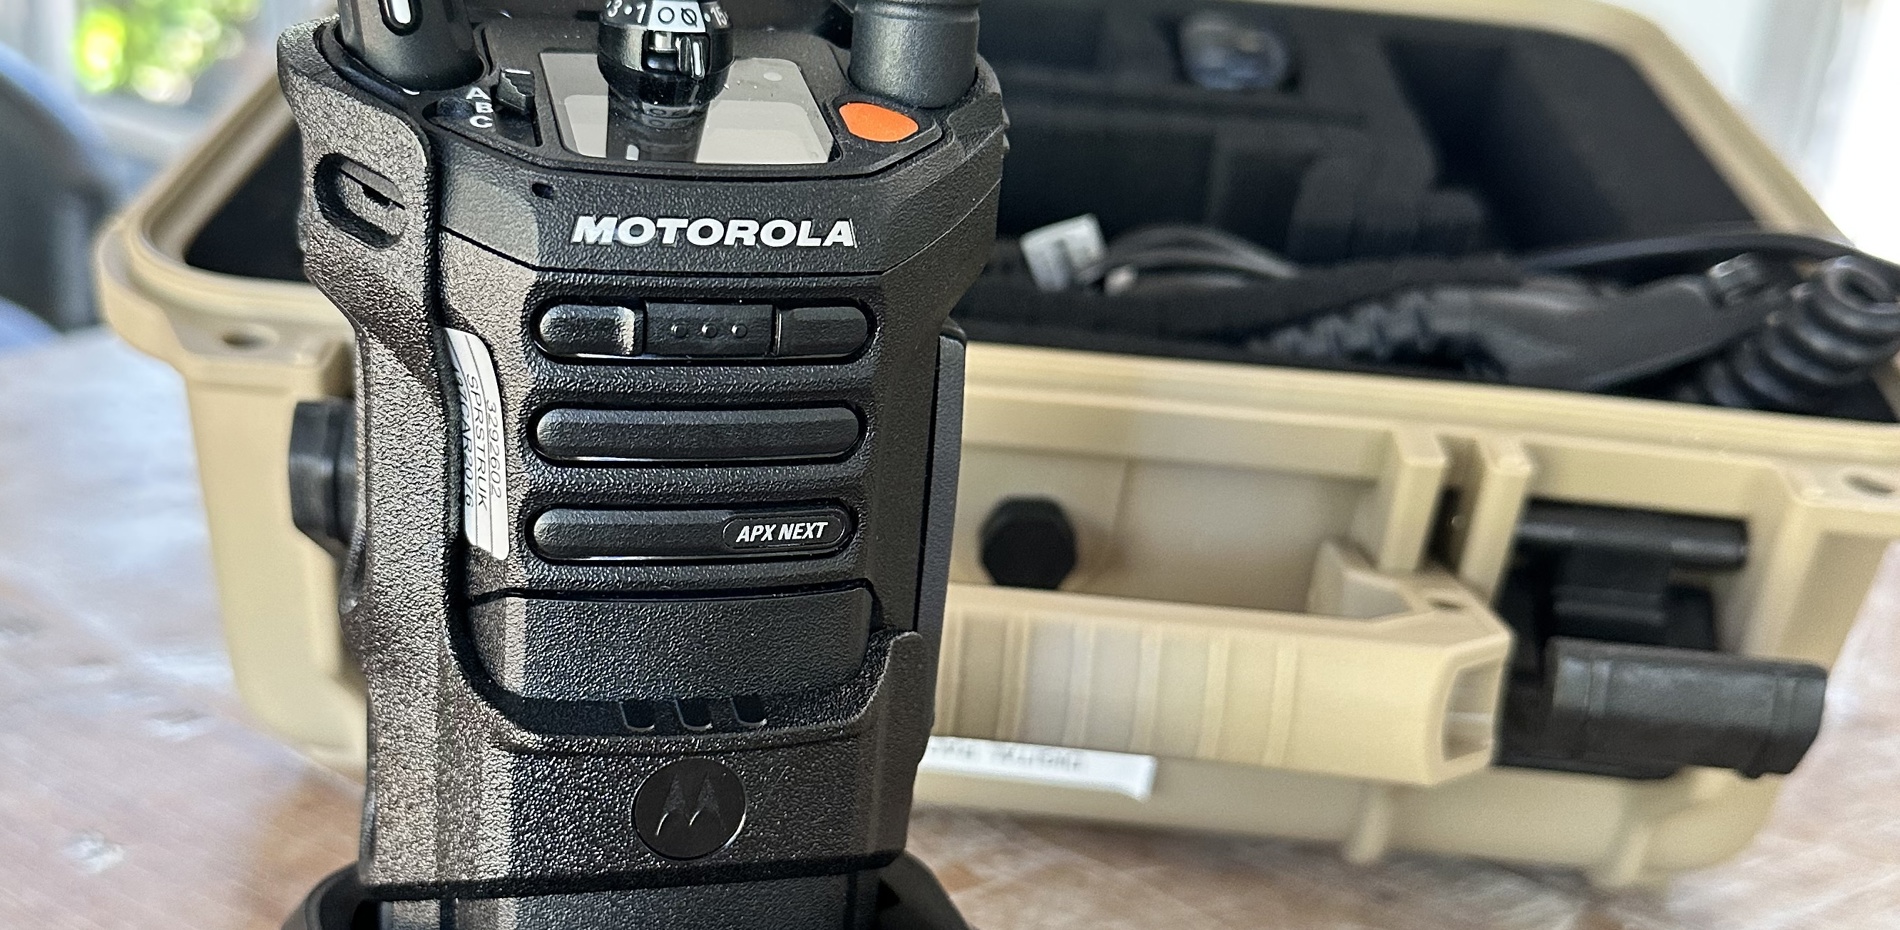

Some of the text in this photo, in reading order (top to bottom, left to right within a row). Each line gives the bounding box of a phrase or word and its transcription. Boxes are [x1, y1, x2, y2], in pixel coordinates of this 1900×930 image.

[465, 87, 492, 101] A
[475, 101, 494, 114] B
[469, 115, 493, 129] C
[571, 215, 855, 248] MOTOROLA
[466, 373, 488, 512] SPRSTRUK
[486, 399, 502, 499] 3292602
[735, 521, 829, 543] APX NEXT
